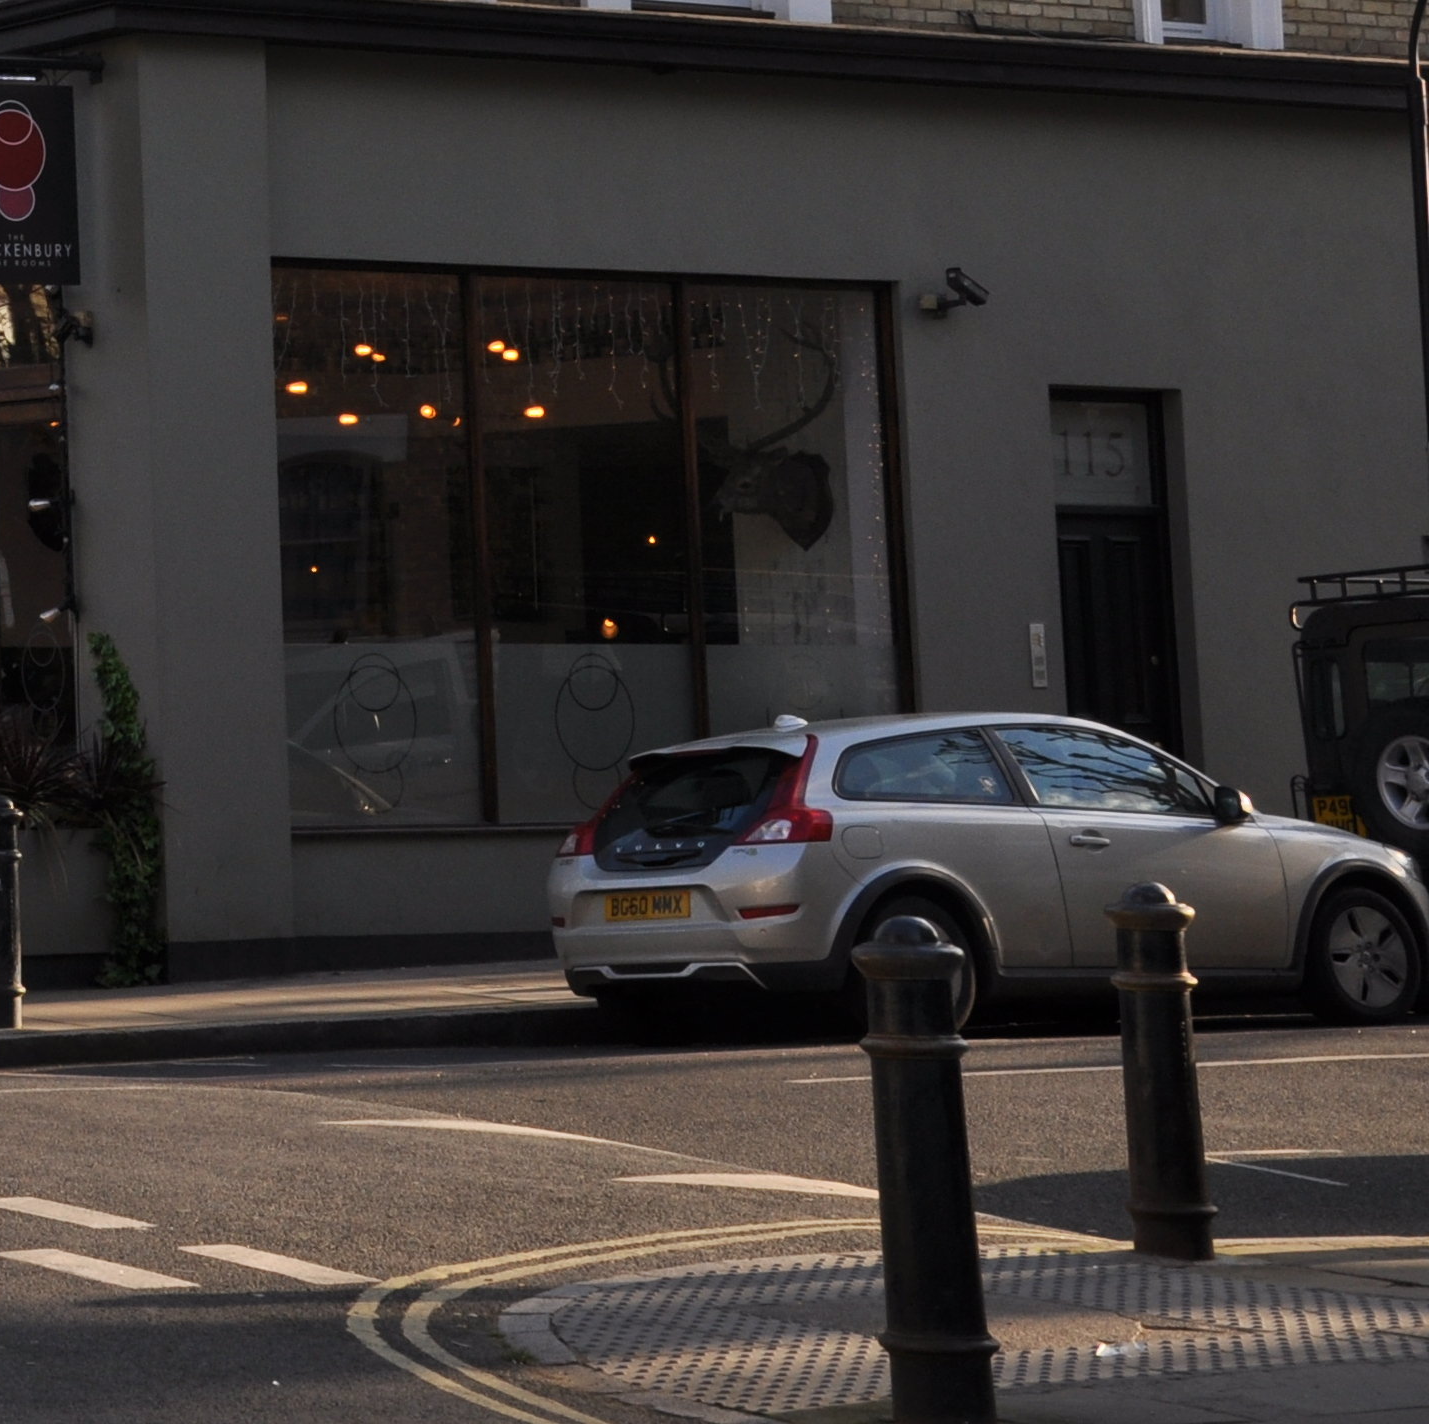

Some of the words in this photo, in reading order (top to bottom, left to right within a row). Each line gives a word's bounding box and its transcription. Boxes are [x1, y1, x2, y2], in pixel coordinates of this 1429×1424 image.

[8, 233, 25, 242] THE
[15, 259, 52, 268] ROOMS
[1059, 430, 1125, 477] 115
[615, 840, 706, 854] VOLVO
[611, 896, 648, 917] BG60
